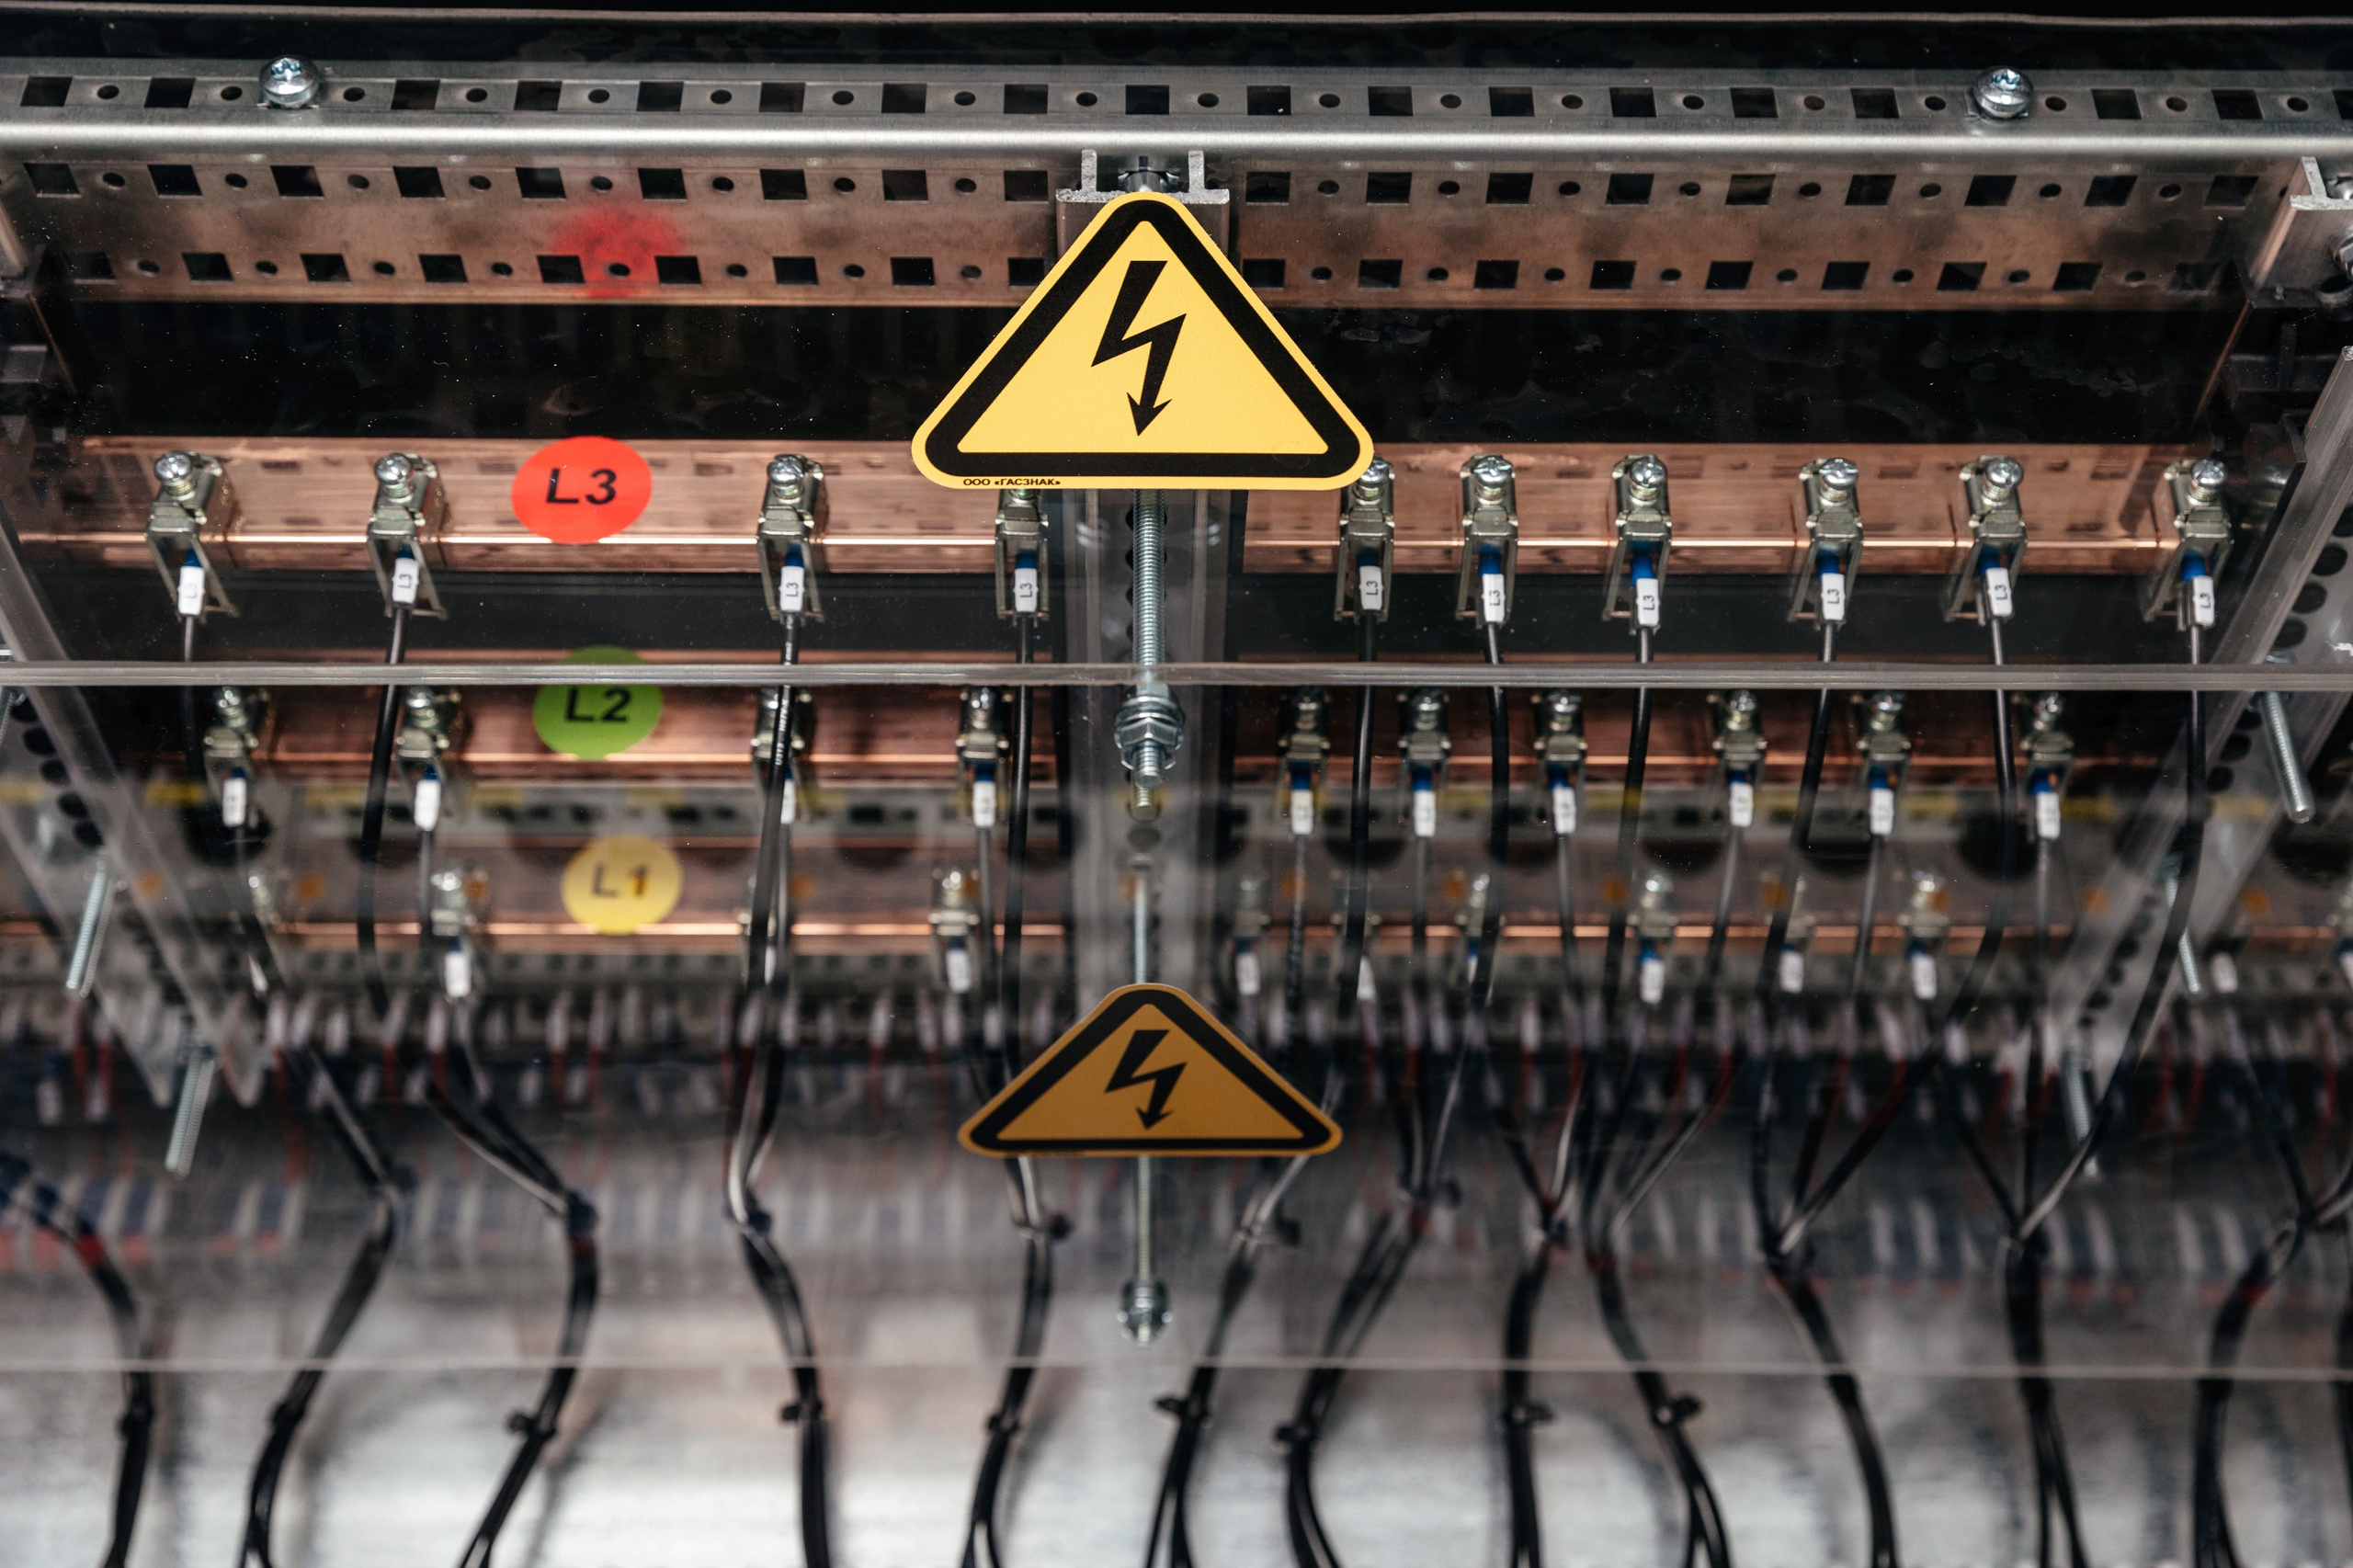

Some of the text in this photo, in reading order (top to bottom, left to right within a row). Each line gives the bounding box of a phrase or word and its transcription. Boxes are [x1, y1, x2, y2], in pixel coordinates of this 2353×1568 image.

[545, 468, 617, 505] L3
[399, 573, 413, 589] L3
[786, 581, 799, 597] L3
[1366, 580, 1379, 596] L3
[1019, 583, 1033, 598] L3
[1488, 589, 1501, 607] L3
[1827, 588, 1840, 605] L3
[1995, 584, 2008, 601] L3
[1643, 595, 1656, 611] L3
[2199, 592, 2212, 609] L3
[566, 687, 631, 722] L2
[592, 864, 649, 898] L1
